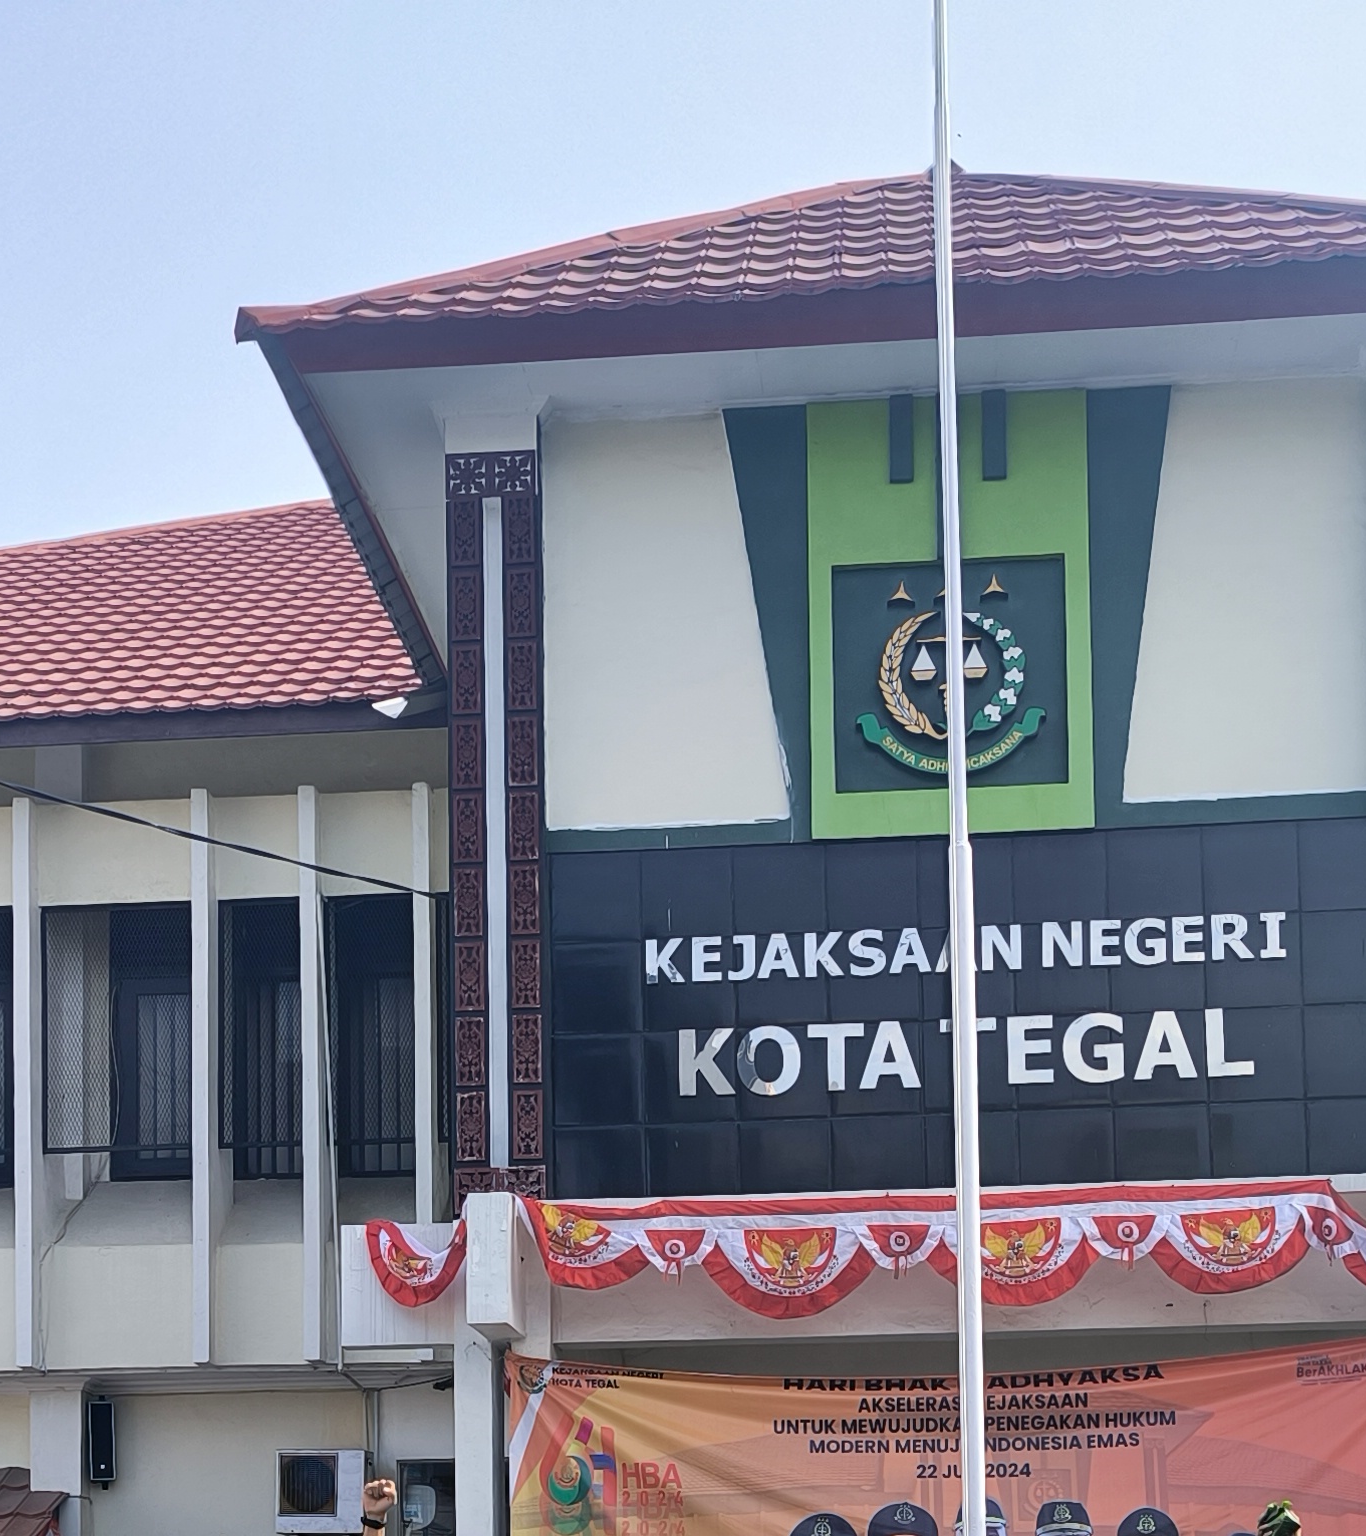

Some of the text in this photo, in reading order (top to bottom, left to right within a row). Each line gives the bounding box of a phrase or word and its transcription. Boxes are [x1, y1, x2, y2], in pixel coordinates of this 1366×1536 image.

[882, 730, 1023, 772] SATYA ADHI ICAKSANA
[1041, 911, 1288, 968] NEGERI
[677, 1020, 922, 1096] KOTA
[585, 1378, 620, 1389] TEGAL
[782, 1364, 1164, 1392] HARI BHAK ADHYAKSA
[858, 1392, 1088, 1414] AKSELERAS EJAKSAAN
[773, 1410, 1176, 1435] UNTUK MEWUJUDKA PENEGAKAN HUKUM
[809, 1432, 1140, 1454] MODERN MENUJ NDONESIA EMAS
[621, 1462, 683, 1489] HBA
[916, 1462, 1031, 1479] 22 JU 2024
[621, 1490, 684, 1507] 2024
